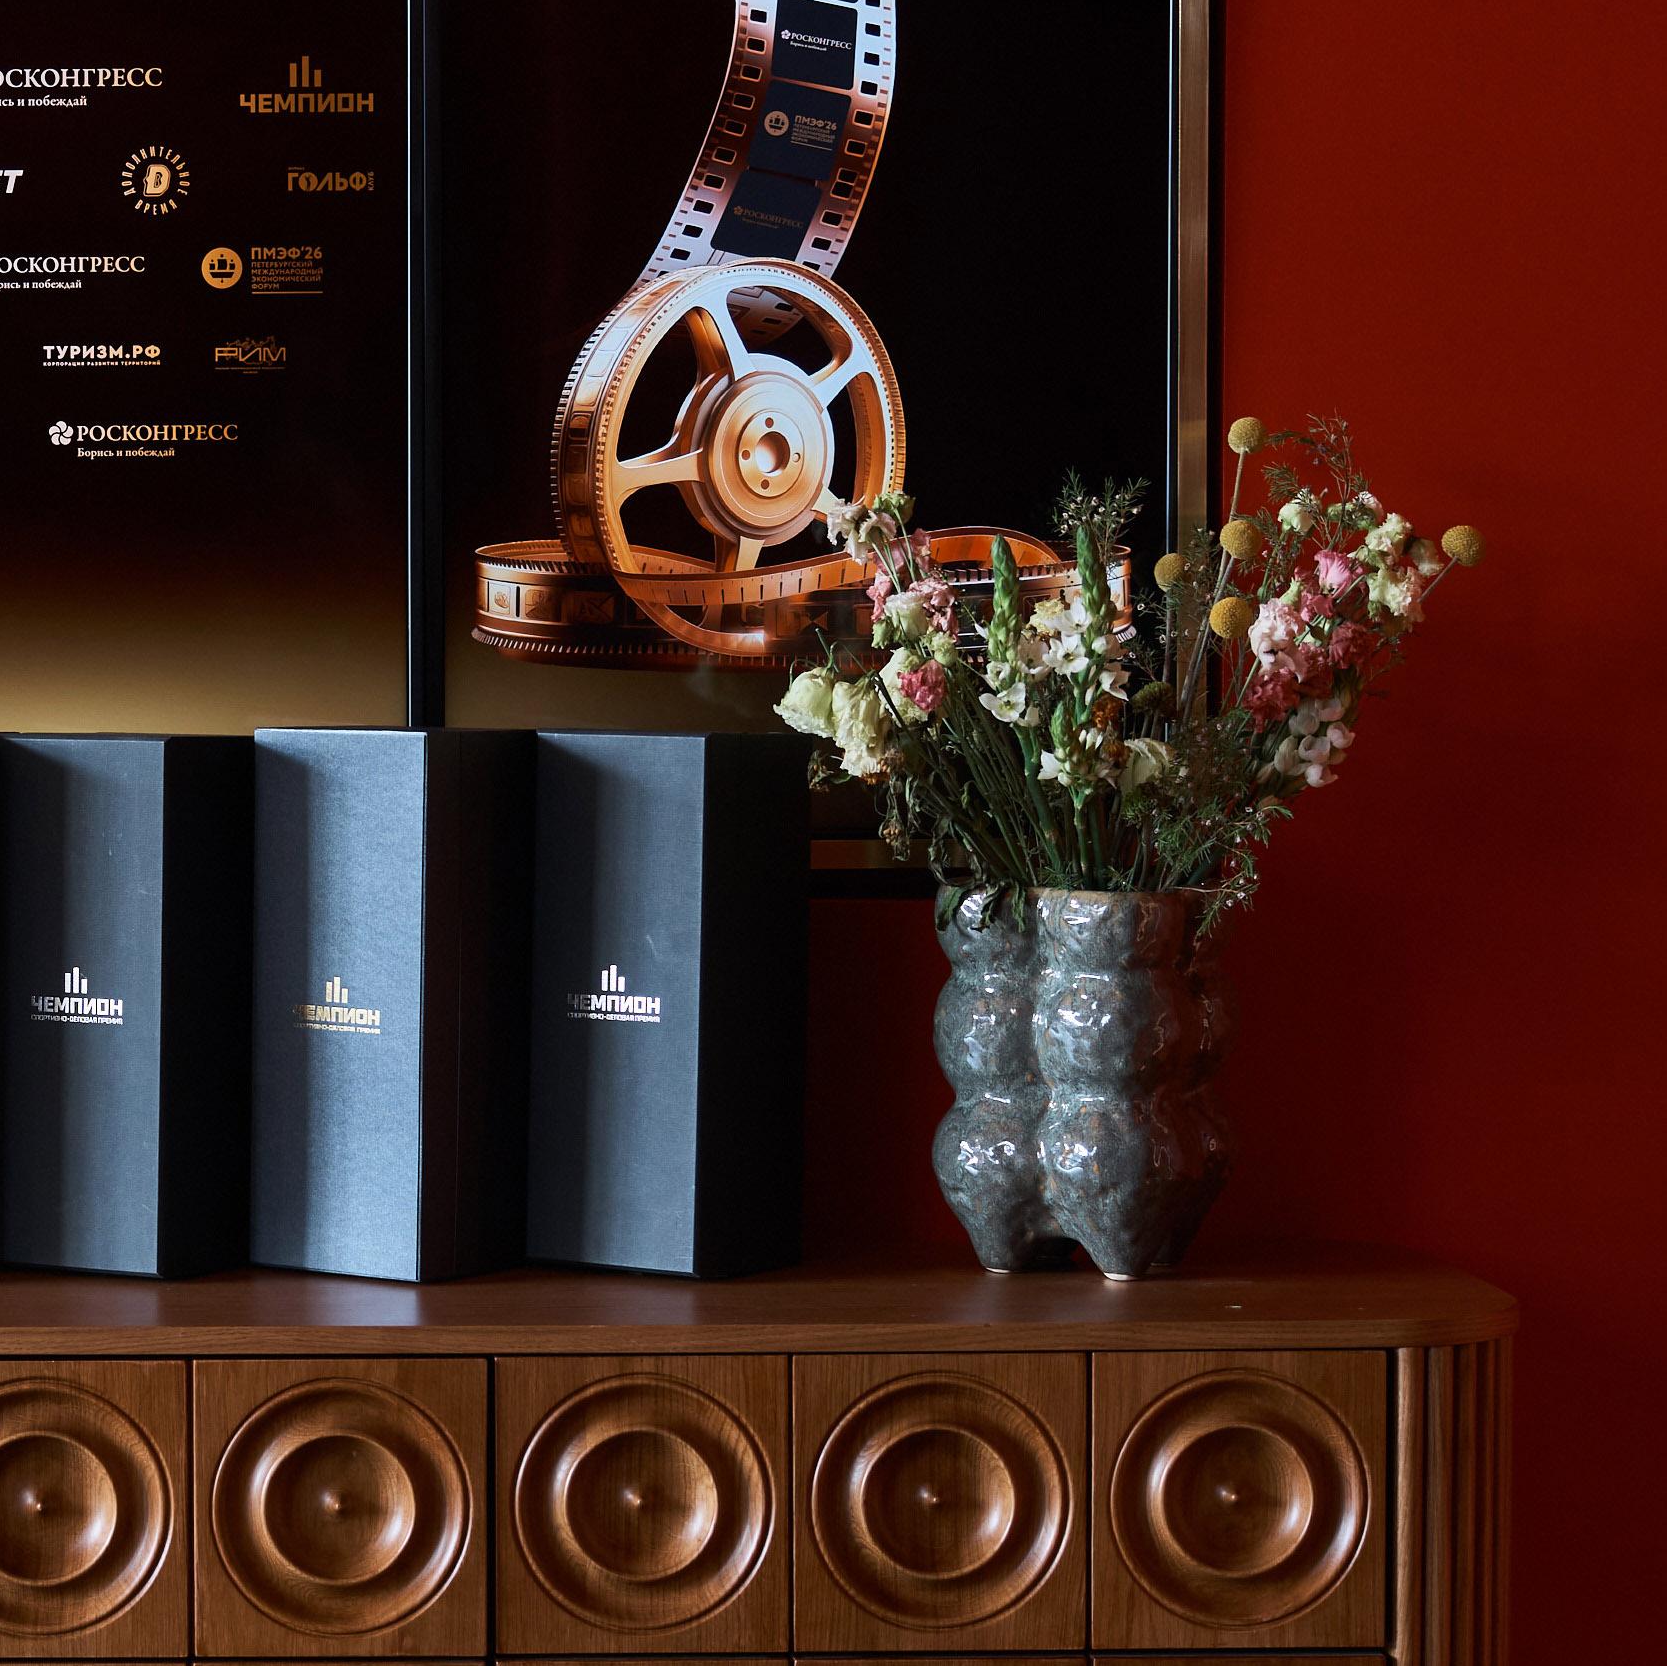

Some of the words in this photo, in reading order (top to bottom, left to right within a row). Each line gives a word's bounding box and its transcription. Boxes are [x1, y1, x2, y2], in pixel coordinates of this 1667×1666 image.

[791, 32, 853, 50] РОСКОНГРЕСС
[17, 97, 25, 107] и
[27, 94, 88, 108] побеждай
[239, 92, 374, 113] ЧЕМПИОН
[287, 171, 367, 192] ГОЛЬФ
[134, 198, 178, 216] ВРЕМЯ
[23, 281, 30, 289] и
[32, 278, 82, 289] побеждай
[42, 344, 161, 359] ТУРИЗМ.РФ
[76, 424, 239, 442] РОСКОНГРЕСС
[77, 447, 114, 460] Борись
[116, 449, 123, 457] и
[125, 447, 175, 458] побеждай
[31, 995, 123, 1016] ЧЕМПИОН
[567, 993, 661, 1014] ЧЕМПИОН
